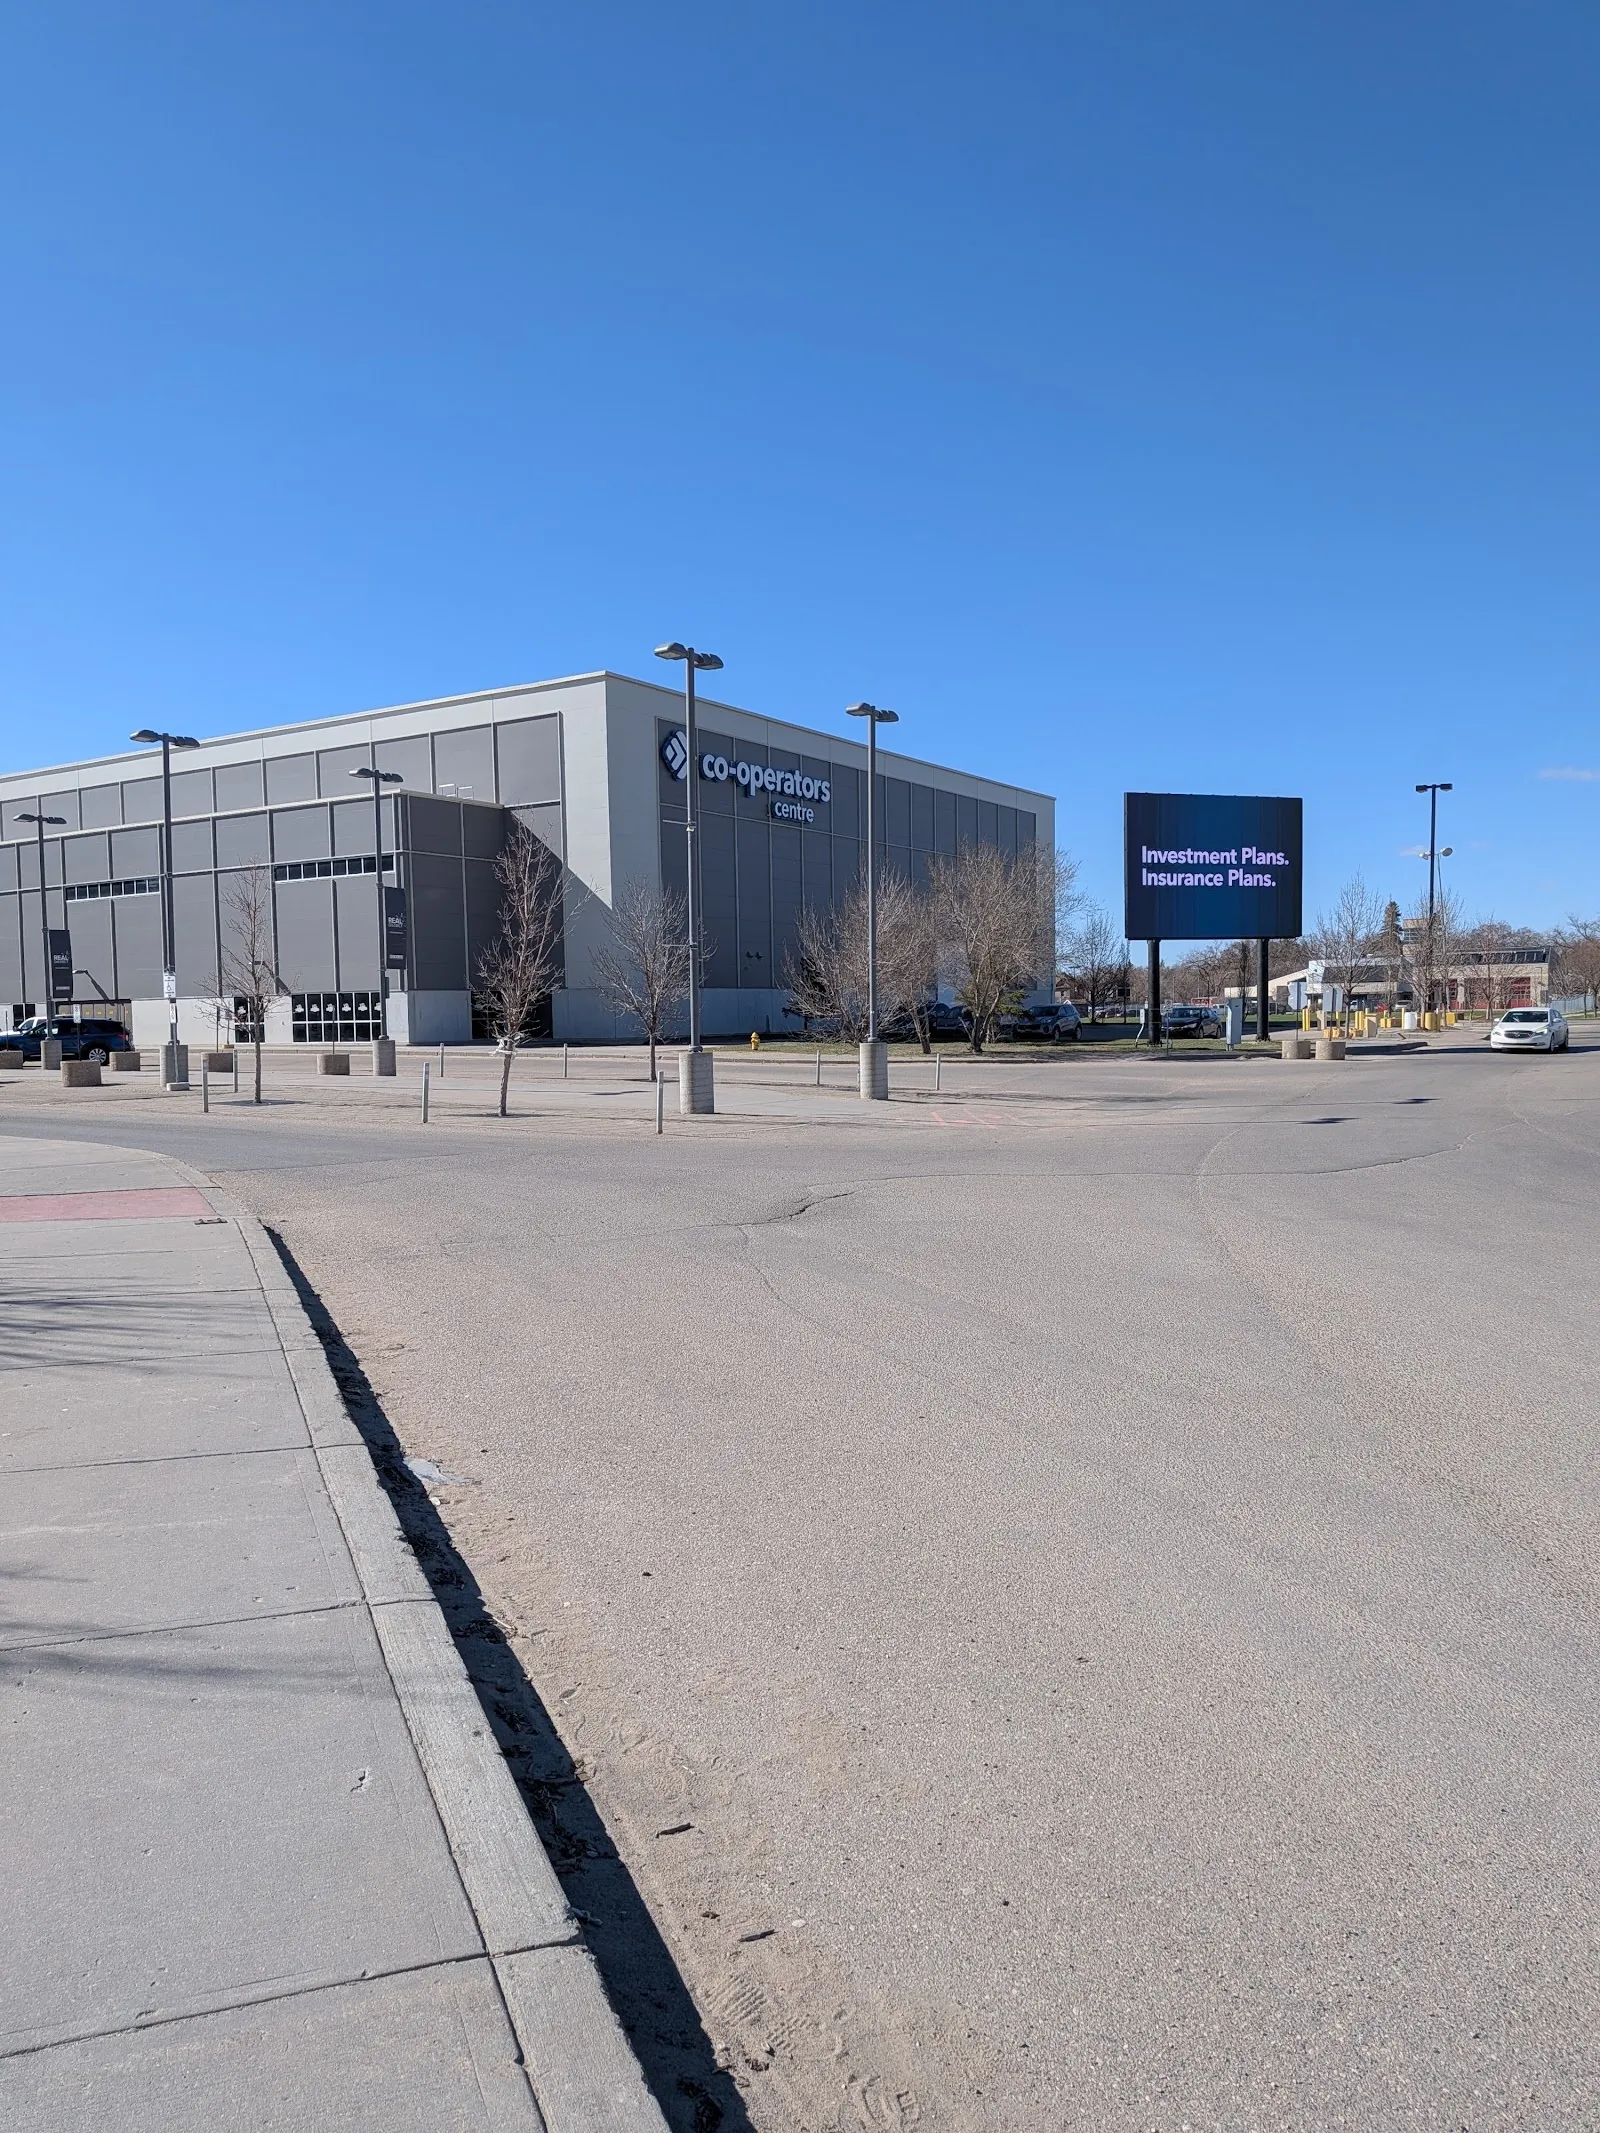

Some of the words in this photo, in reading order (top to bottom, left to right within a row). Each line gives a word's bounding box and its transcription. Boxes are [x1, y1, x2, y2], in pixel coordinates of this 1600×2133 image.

[702, 754, 831, 802] co-operators
[774, 801, 815, 823] centre
[1141, 845, 1237, 865] Investment
[1241, 846, 1290, 866] Plans.
[1142, 868, 1224, 887] Insurance
[1228, 868, 1277, 887] Plans.
